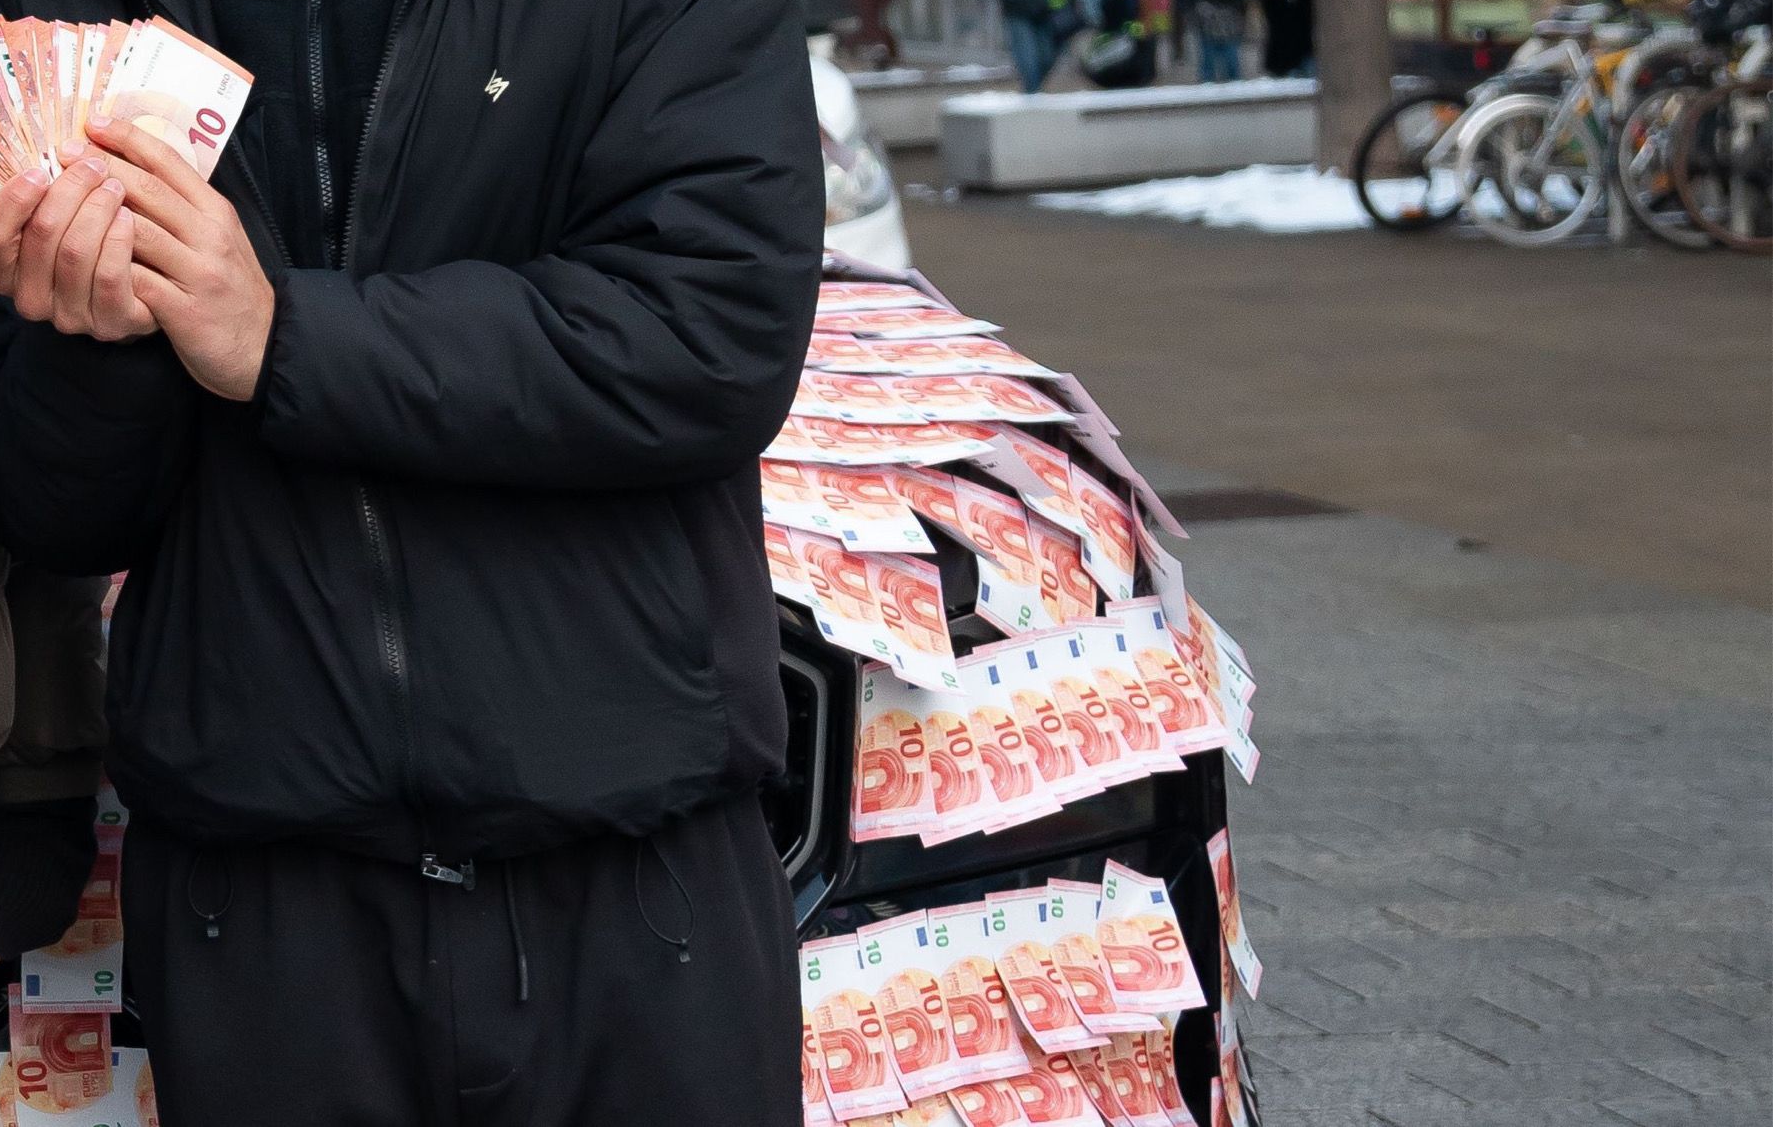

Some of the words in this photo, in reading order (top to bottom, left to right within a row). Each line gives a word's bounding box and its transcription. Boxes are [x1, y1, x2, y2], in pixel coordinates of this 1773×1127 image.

[216, 73, 231, 96] EURO
[188, 107, 227, 150] 10
[822, 494, 854, 512] 10
[808, 573, 834, 601] 10
[1040, 570, 1059, 602] 10
[880, 602, 905, 631] 10
[1018, 604, 1032, 627] 10
[941, 671, 960, 689] 10
[1163, 657, 1192, 688] 10
[1080, 686, 1108, 719] 10
[1123, 680, 1150, 711] 10
[1035, 699, 1062, 734] 10
[899, 721, 925, 759] 10
[946, 721, 974, 758] 10
[994, 714, 1022, 751] 10
[1106, 878, 1117, 900] 10
[992, 908, 1006, 932] 10
[1051, 895, 1064, 918] 10
[935, 924, 949, 948] 10
[1148, 921, 1179, 952] 10
[866, 940, 882, 965] 10
[94, 970, 115, 995] 10
[806, 956, 822, 981] 10
[920, 978, 943, 1015] 10
[982, 974, 1006, 1005] 10
[857, 1001, 882, 1038] 10
[17, 1060, 48, 1100] 10
[82, 1073, 90, 1098] EURO
